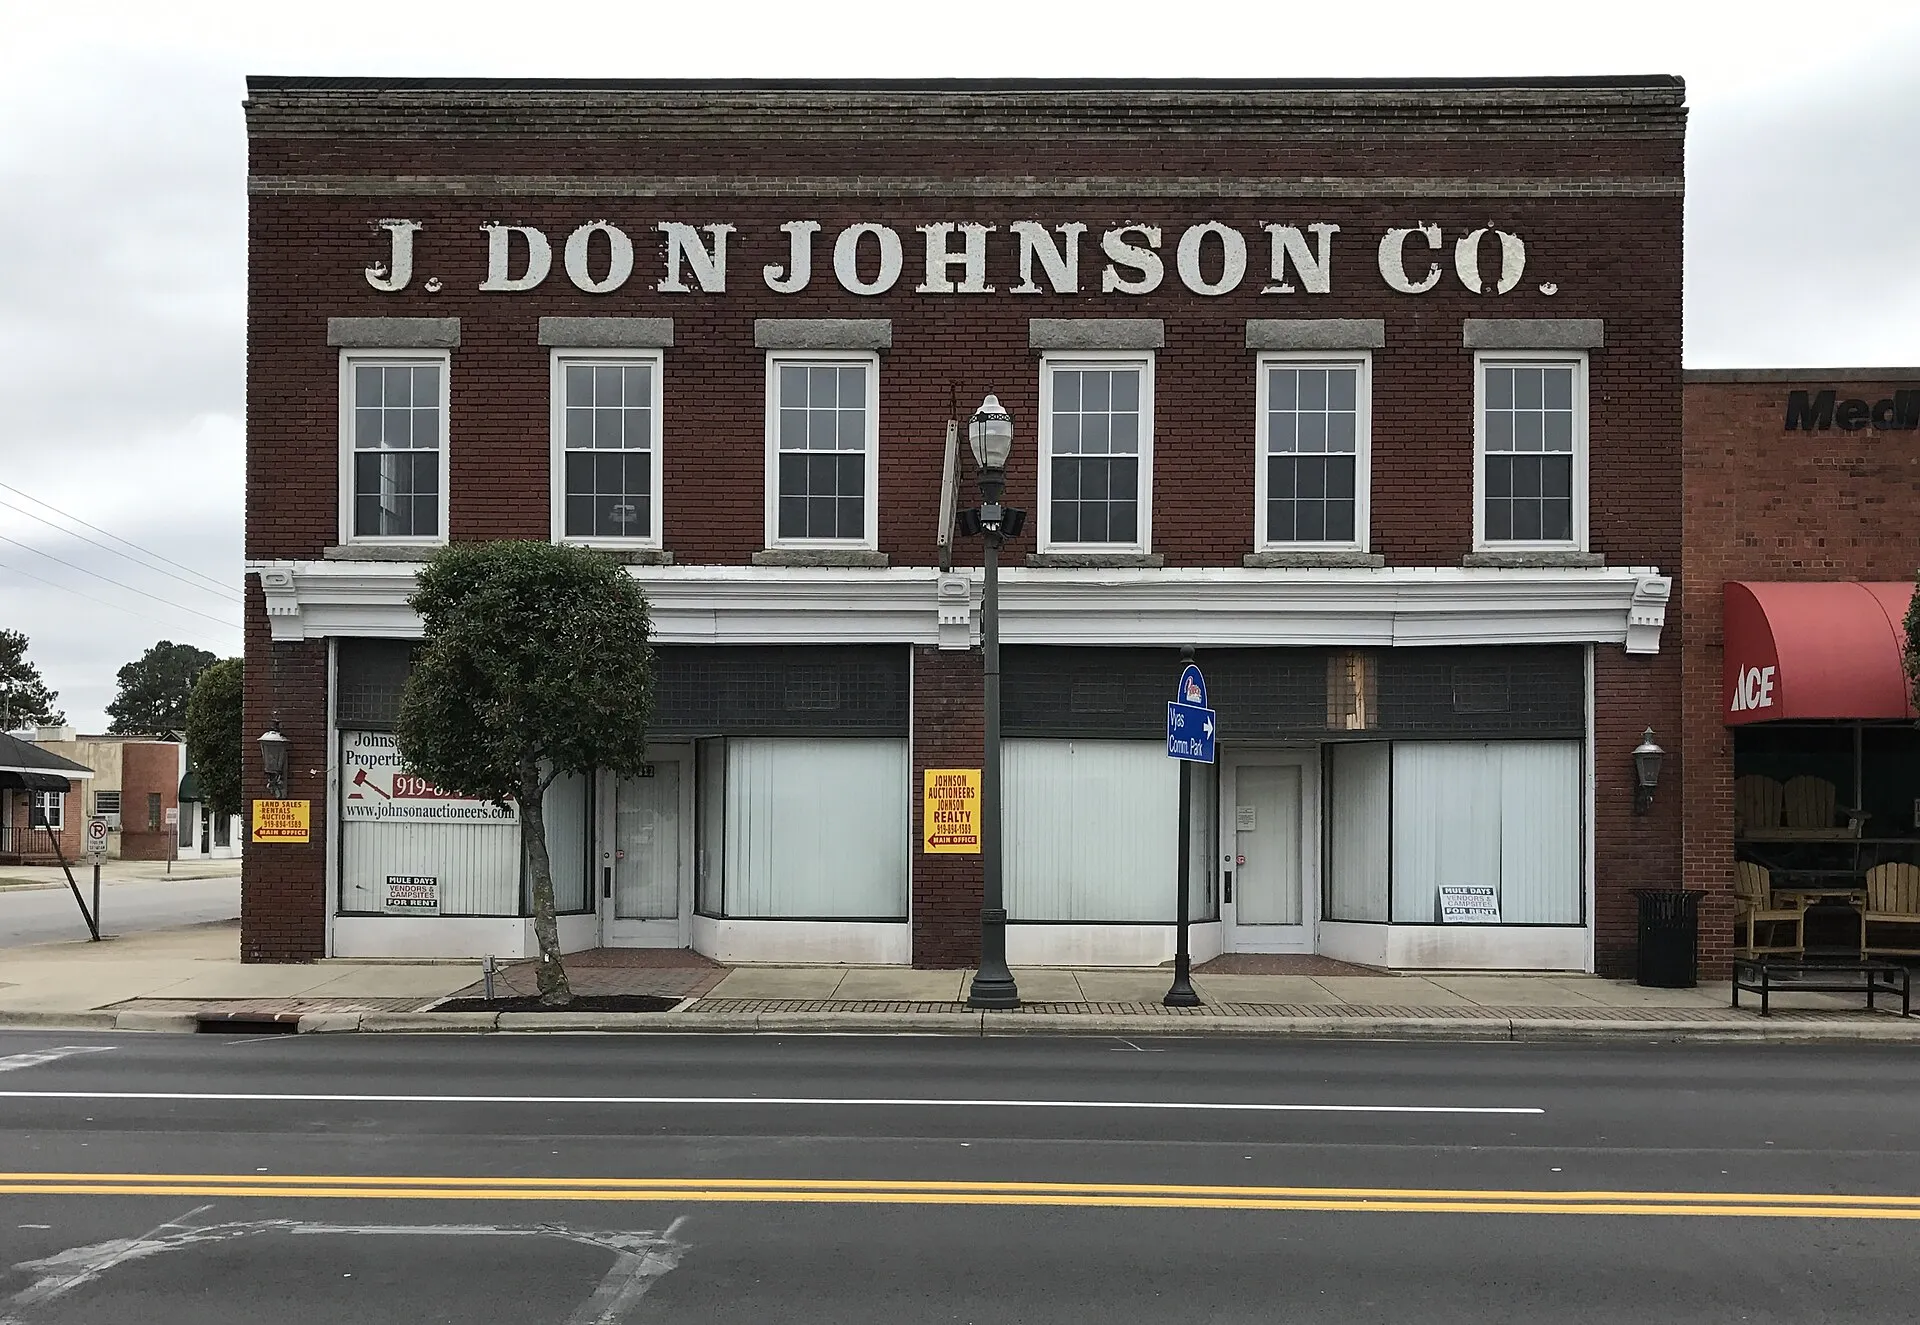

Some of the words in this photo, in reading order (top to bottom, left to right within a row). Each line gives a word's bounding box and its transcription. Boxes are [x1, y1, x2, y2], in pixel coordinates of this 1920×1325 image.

[365, 218, 442, 293] J.
[479, 219, 736, 294] DON
[762, 220, 1340, 295] JOHNSON
[1377, 219, 1559, 295] CO.
[1731, 663, 1775, 711] ACE
[1169, 707, 1185, 731] Vyas
[1190, 737, 1203, 756] Park
[934, 775, 967, 787] JOHNSON
[928, 787, 975, 799] AUCTIONEERS
[346, 802, 515, 820] www.johnsonauctioneers.com
[937, 799, 965, 811] JOHNSON
[933, 811, 971, 823] REALTY
[413, 877, 435, 885] DAYS
[390, 891, 435, 899] CAMPSITES
[1447, 900, 1493, 908] CAMPSITES
